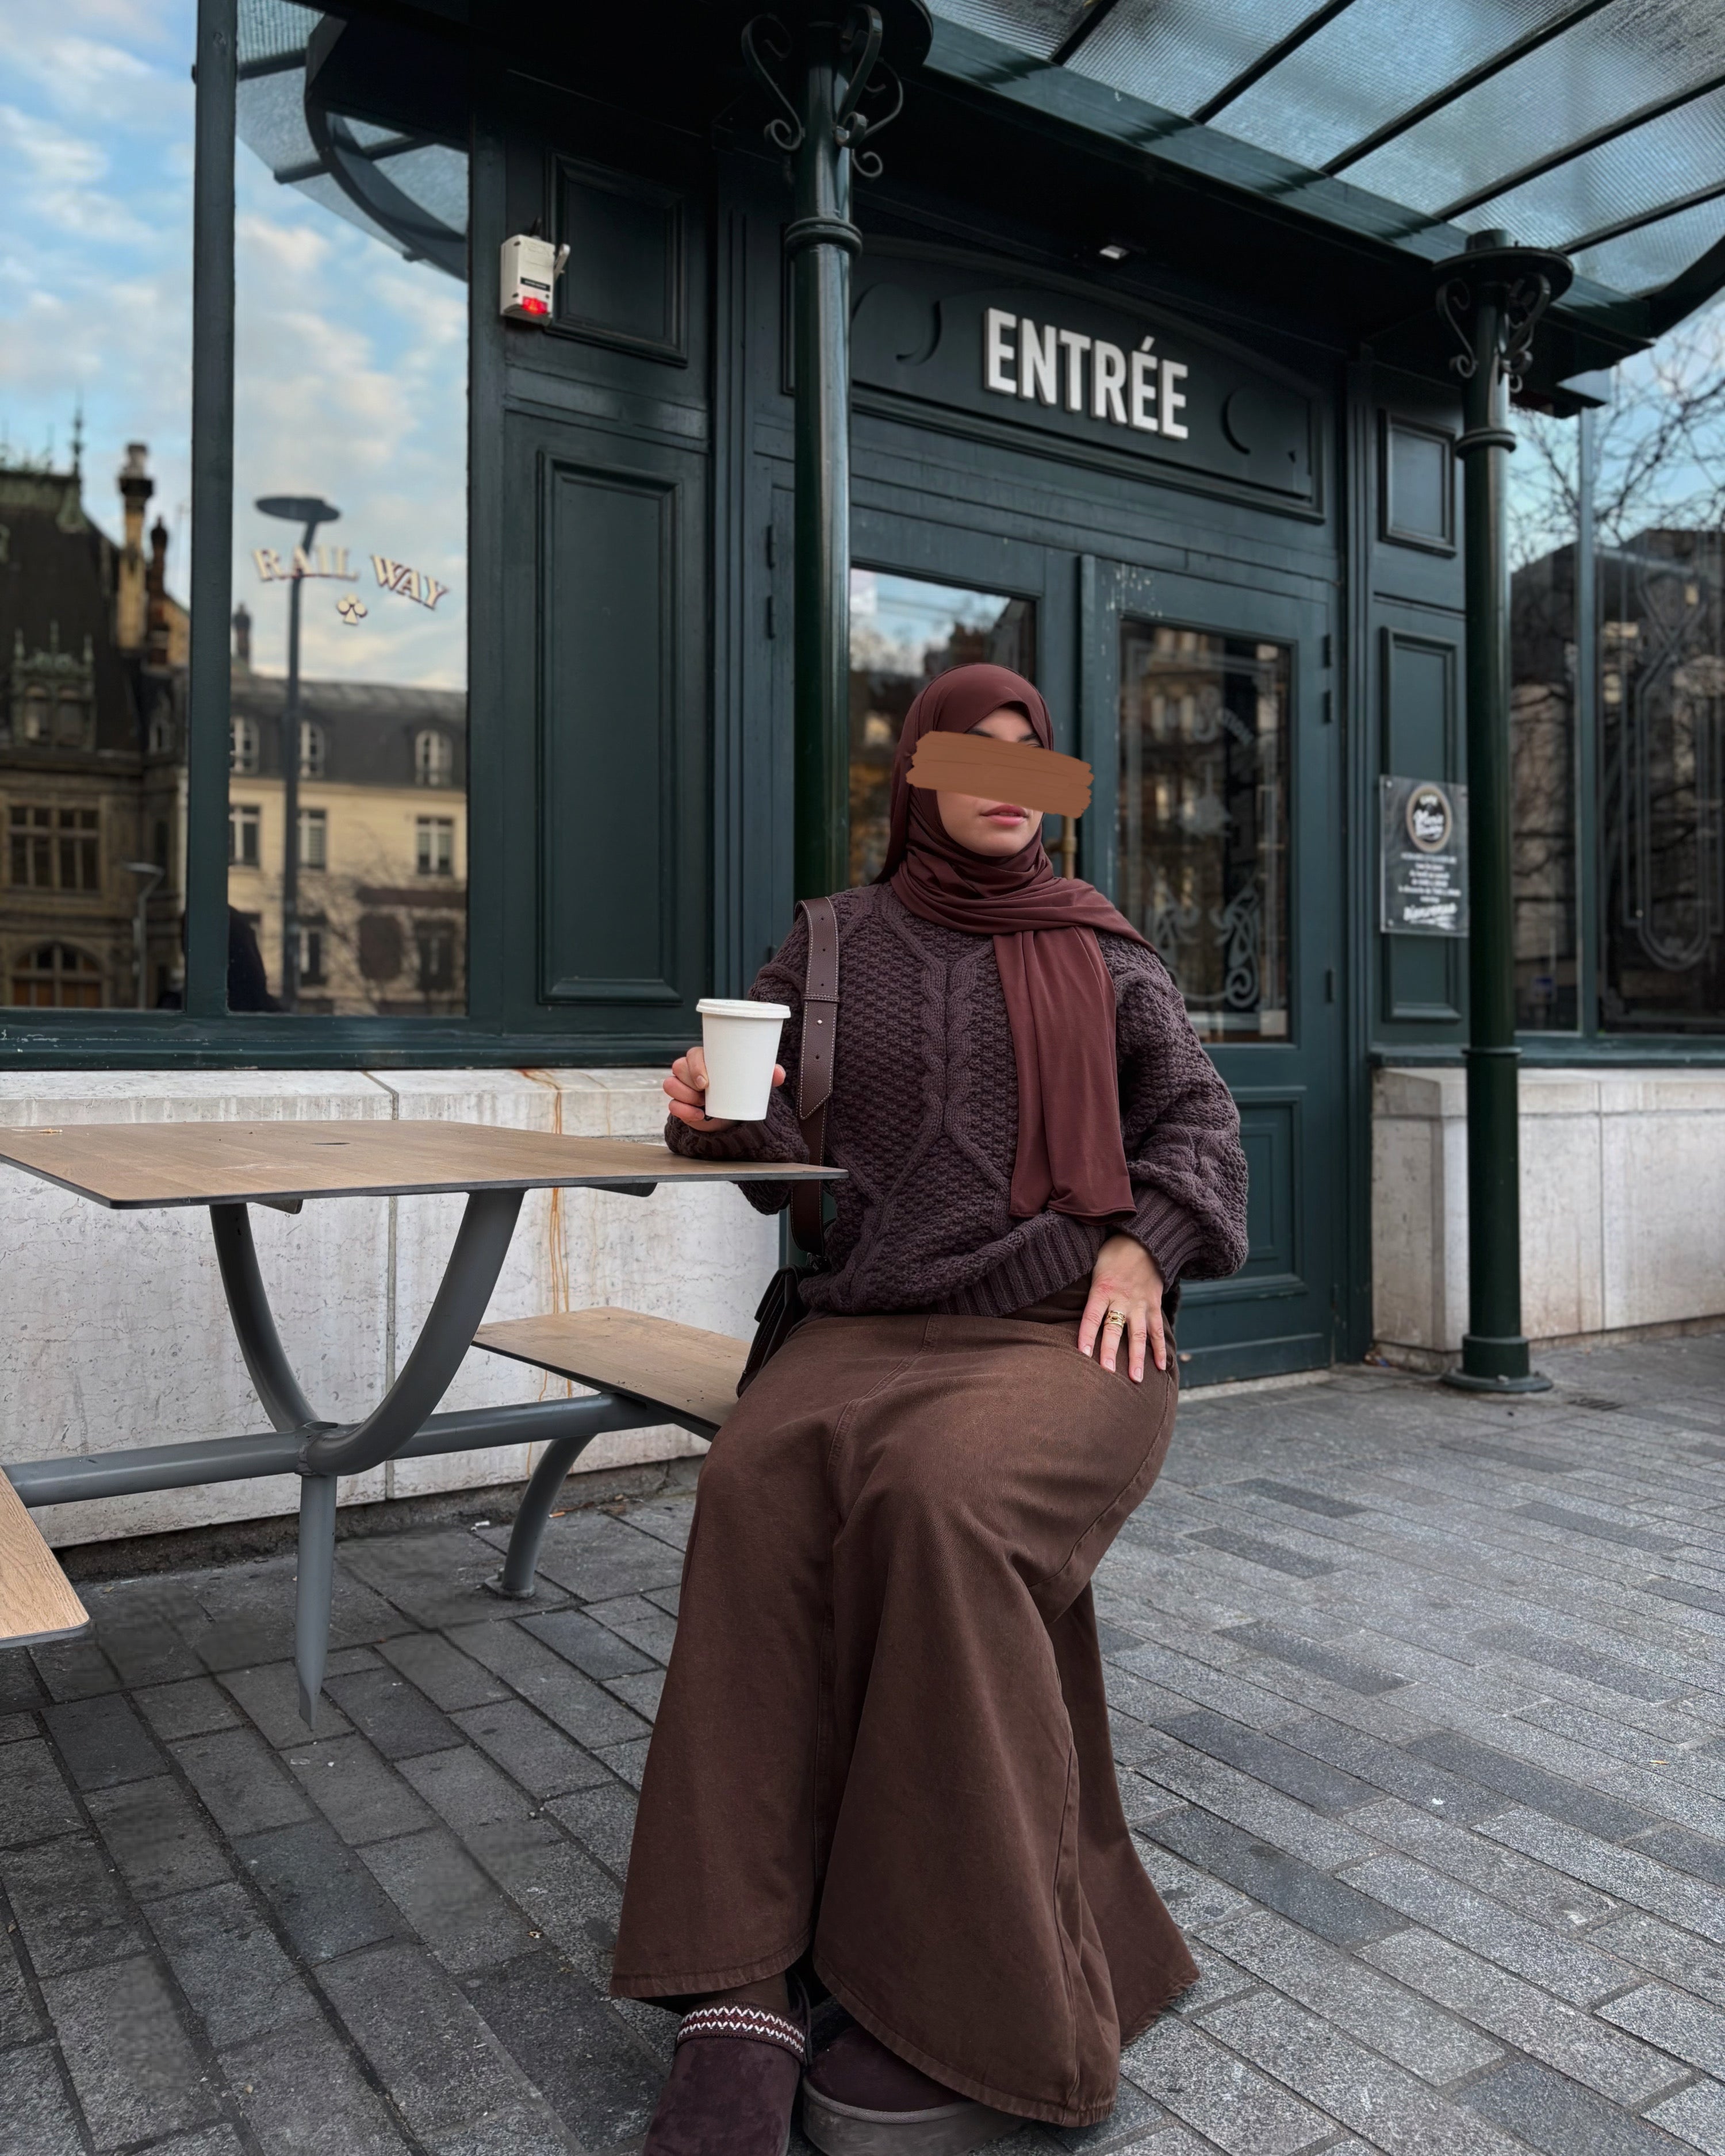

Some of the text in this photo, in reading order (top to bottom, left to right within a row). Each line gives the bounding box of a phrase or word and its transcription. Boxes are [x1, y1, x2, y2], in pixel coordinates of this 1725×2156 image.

[984, 308, 1189, 439] ENTRÉE
[252, 546, 449, 611] RAIL WAY
